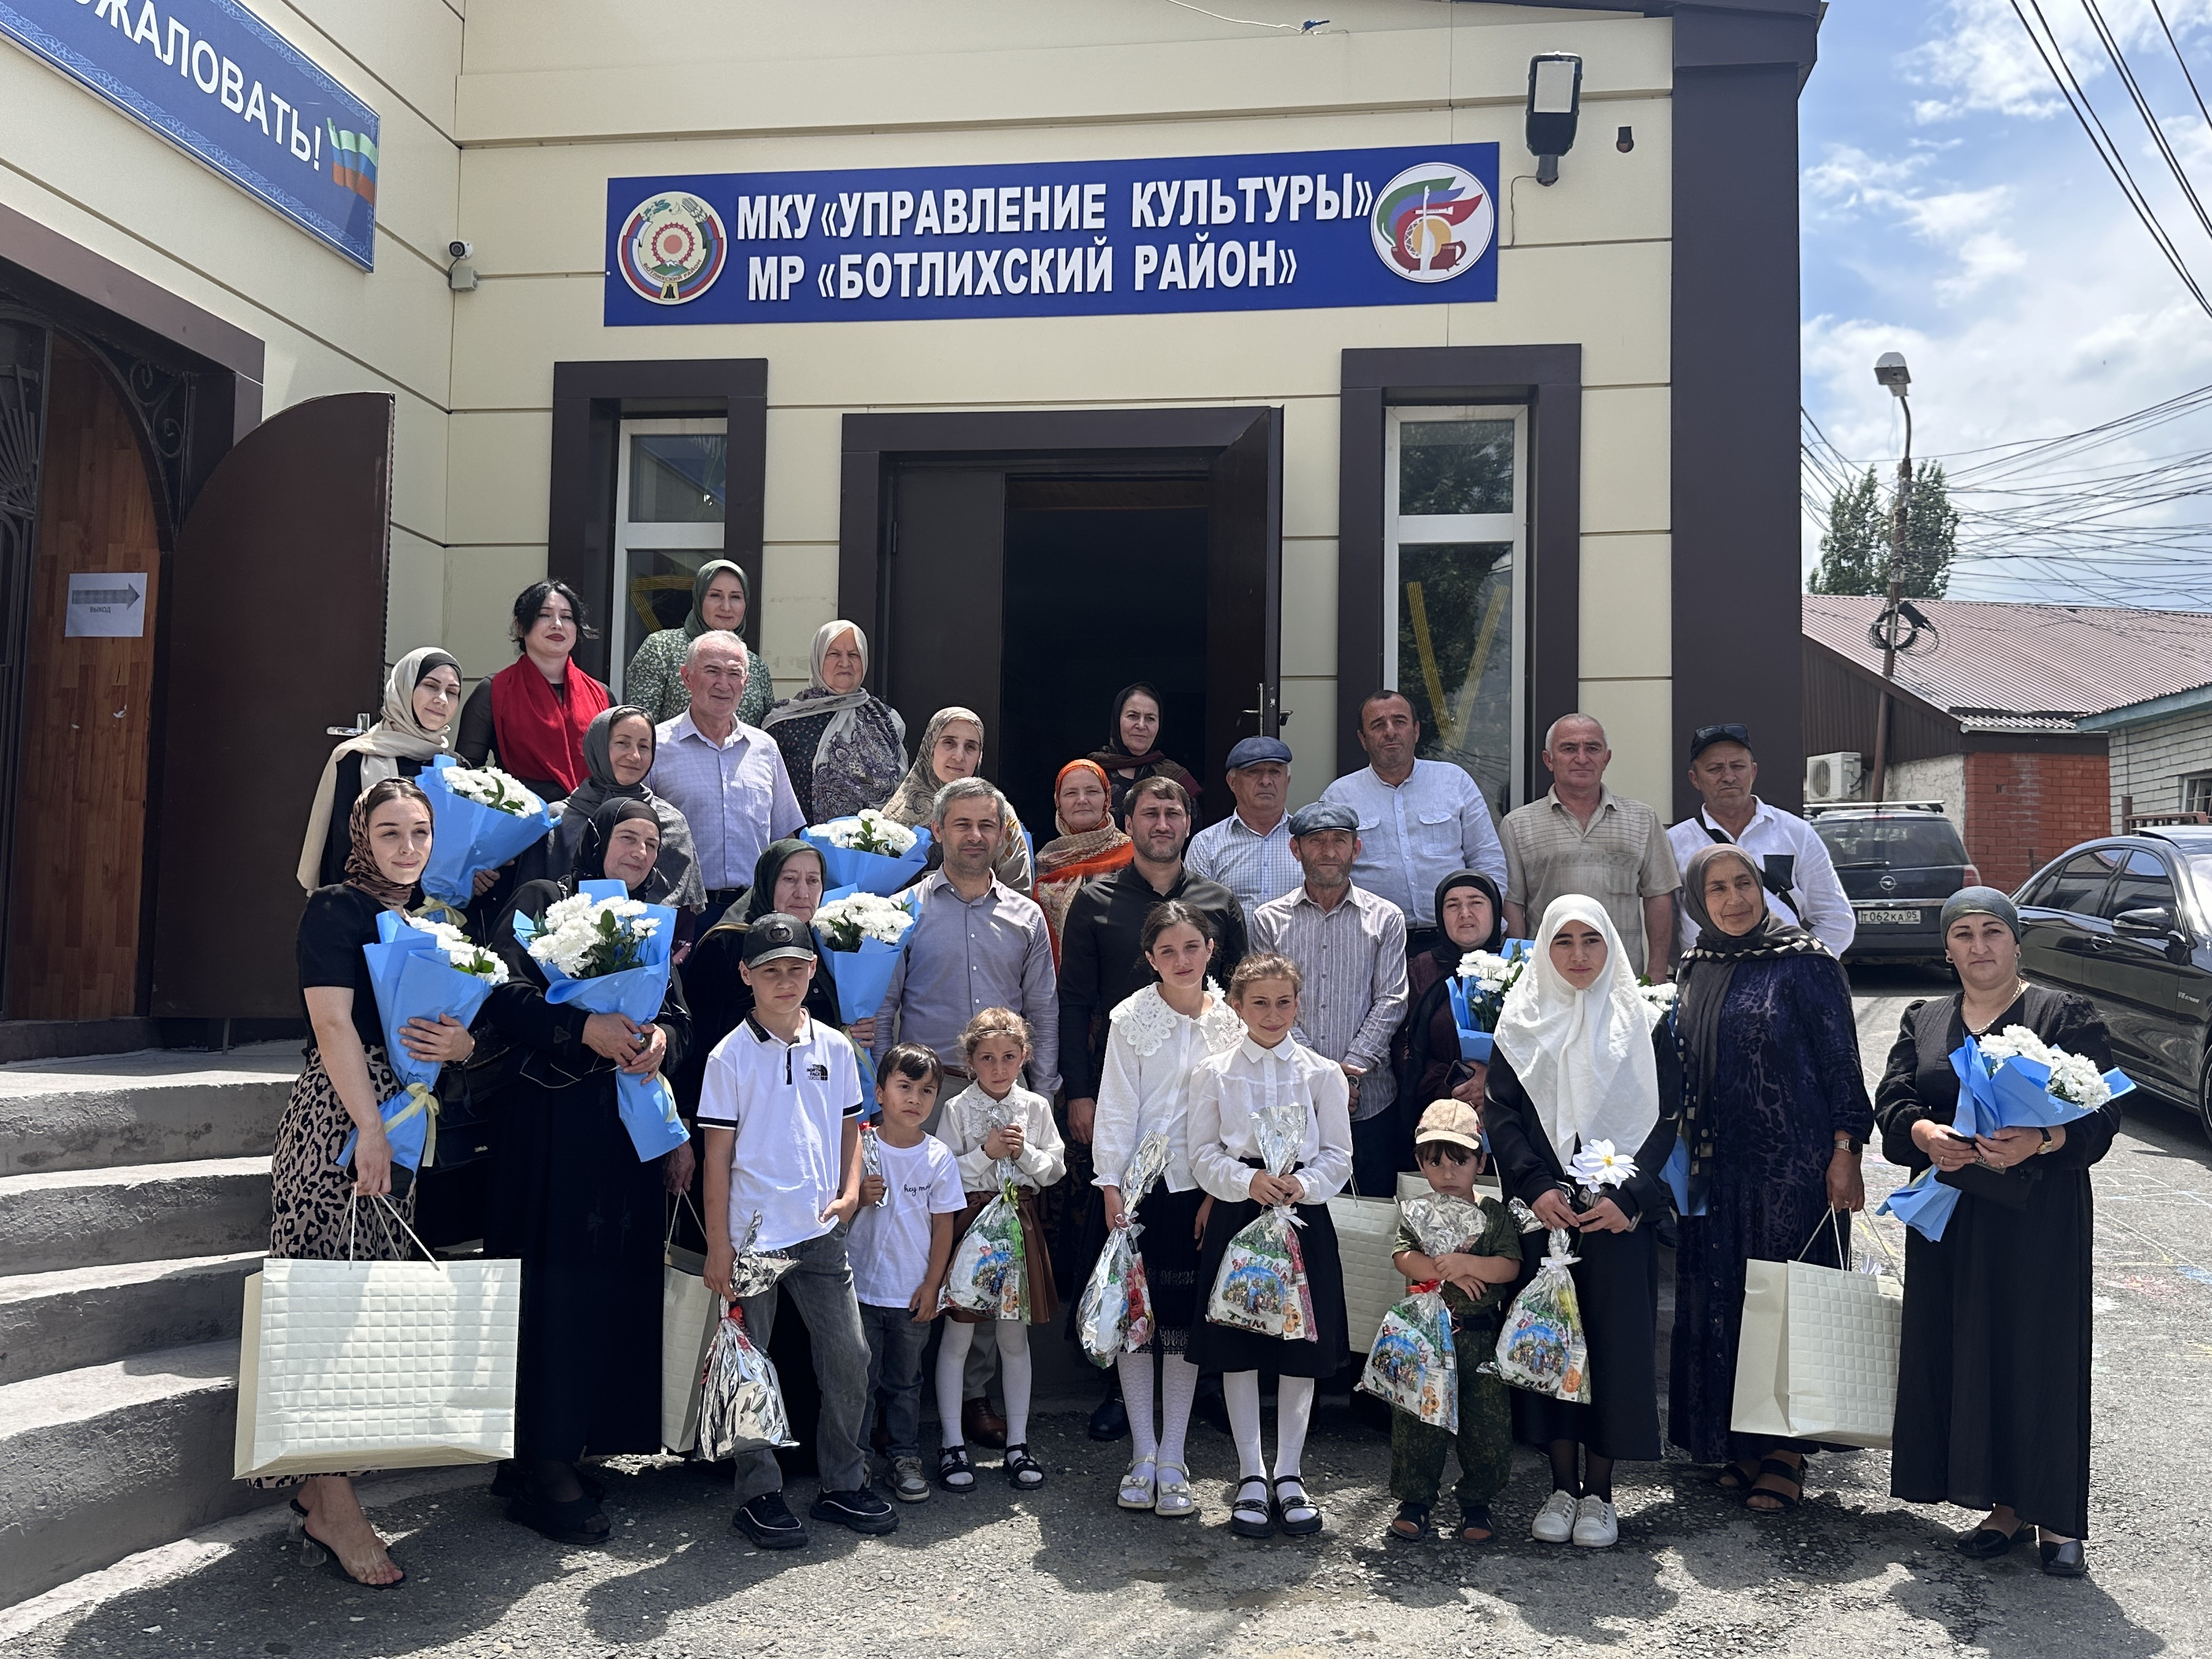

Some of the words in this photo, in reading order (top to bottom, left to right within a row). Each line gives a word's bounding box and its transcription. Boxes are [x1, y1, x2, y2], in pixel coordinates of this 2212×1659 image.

[75, 0, 320, 171] ЖАЛОВАТЬ!
[737, 193, 816, 240] МКУ
[820, 183, 1106, 237] «УПРАВЛЕНИЕ
[1132, 173, 1373, 228] КУЛЬТУРЫ»
[748, 256, 805, 300] МР
[818, 236, 1113, 299] «БОТЛИХСКИЙ
[1134, 232, 1297, 291] РАЙОН»
